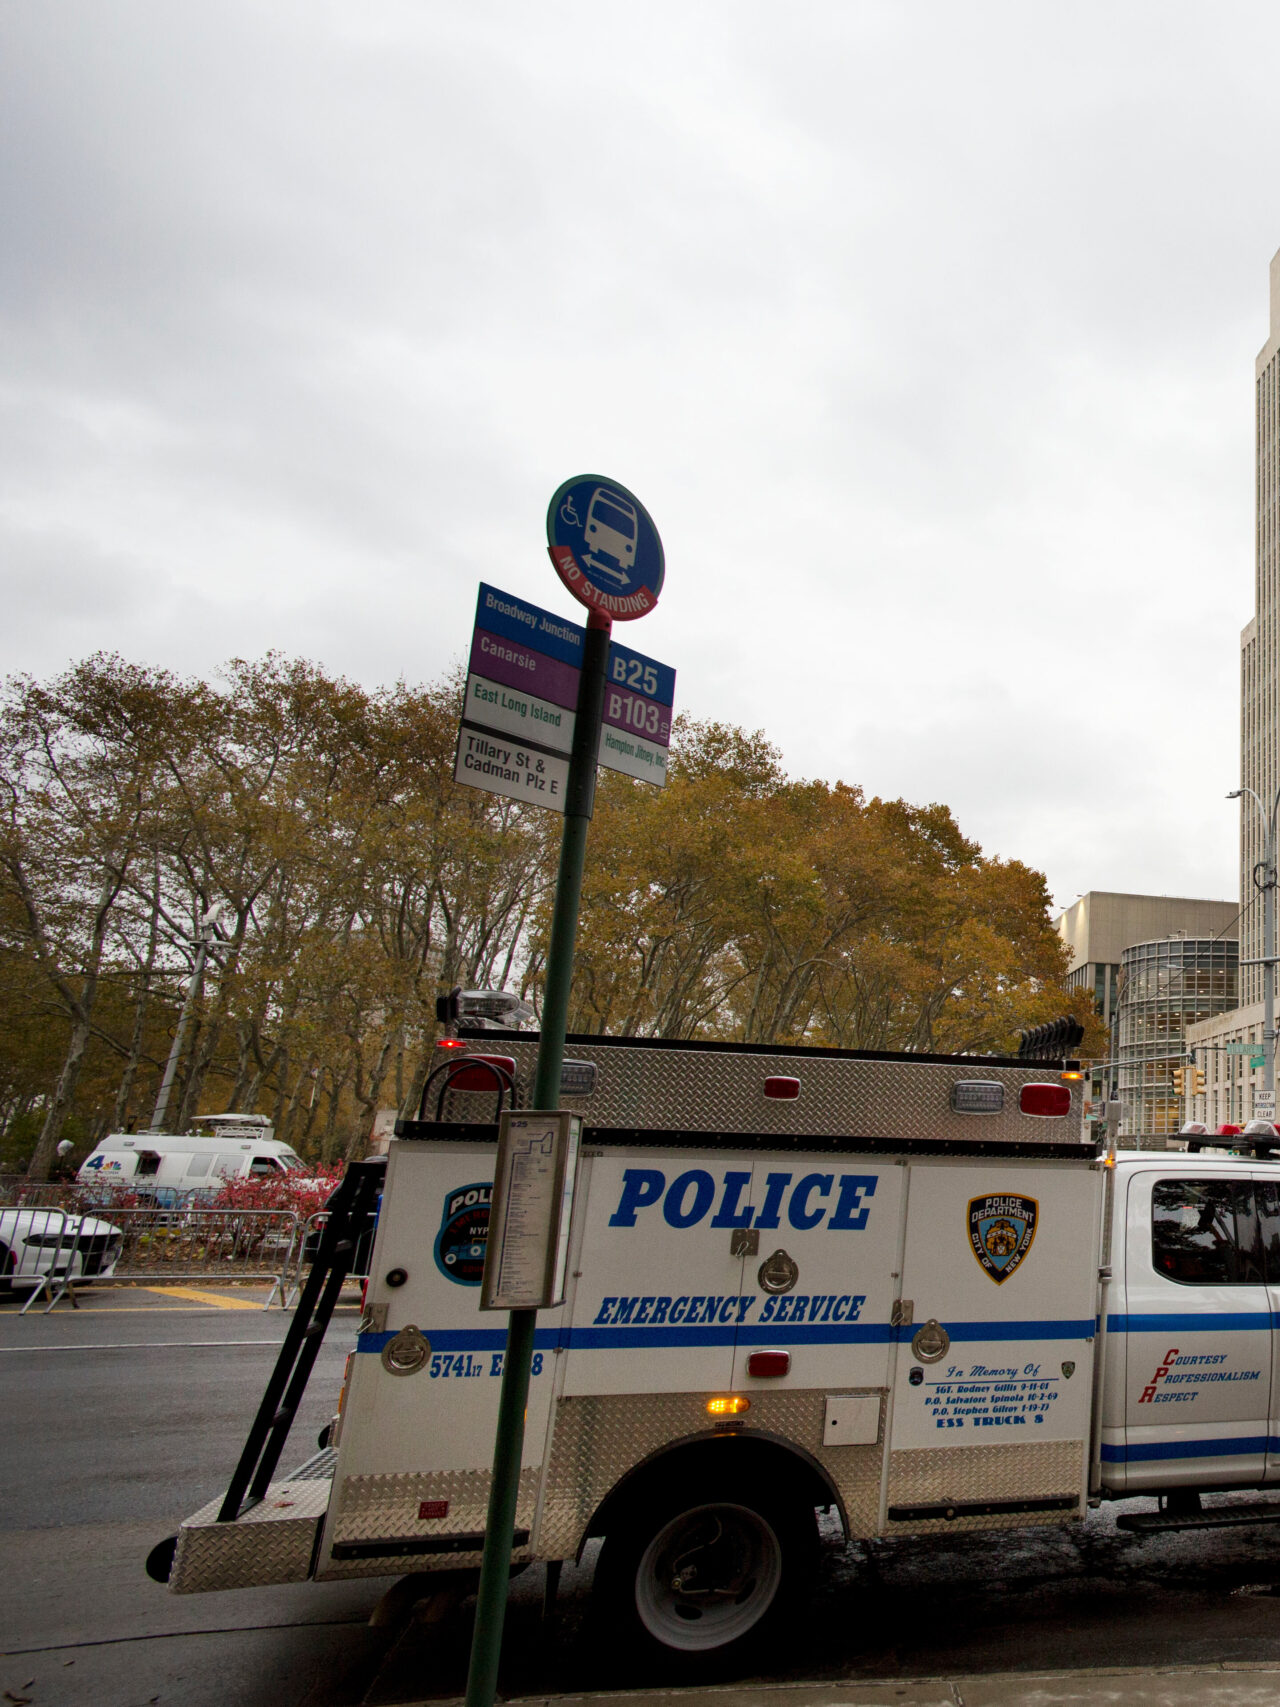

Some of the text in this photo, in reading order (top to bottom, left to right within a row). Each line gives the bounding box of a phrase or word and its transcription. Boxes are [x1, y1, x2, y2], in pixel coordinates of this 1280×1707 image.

[560, 556, 581, 580] NO
[581, 581, 649, 613] STANDING
[486, 593, 580, 646] Broadway Junction
[481, 637, 536, 671] Canarsie
[613, 656, 658, 695] B25
[474, 683, 561, 727] East Long Island
[608, 693, 659, 734] B103
[605, 732, 634, 756] Hampton
[467, 736, 546, 774] Tillary St &
[464, 753, 559, 795] Cadman Plz E
[1257, 1110, 1272, 1118] CLEAR
[86, 1155, 105, 1170] 4
[450, 1189, 493, 1215] POLI
[608, 1169, 879, 1230] POLICE
[985, 1197, 1022, 1208] POLICE
[971, 1206, 1034, 1222] DEPARTMENT
[469, 1227, 489, 1235] NYP
[1019, 1228, 1034, 1250] YORK
[972, 1233, 993, 1269] CITY OF
[1005, 1253, 1021, 1273] NEW
[593, 1295, 867, 1325] EMERGENCY SERVICE
[1163, 1349, 1228, 1366] COURTESY
[945, 1363, 1042, 1380] In Memory Of
[1151, 1367, 1261, 1384] PROFESSIONALISM
[935, 1382, 1050, 1394] SGT. Rodney Gillis 9-11-01
[1138, 1386, 1199, 1403] RESPECT
[925, 1397, 942, 1405] P.O.
[946, 1396, 987, 1405] Salvatore
[990, 1394, 1024, 1404] Spinola
[932, 1407, 949, 1416] P.O.
[953, 1406, 989, 1416] Stephen
[992, 1404, 1018, 1414] Gilroy
[936, 1414, 1044, 1428] ESS TRUCK 8
